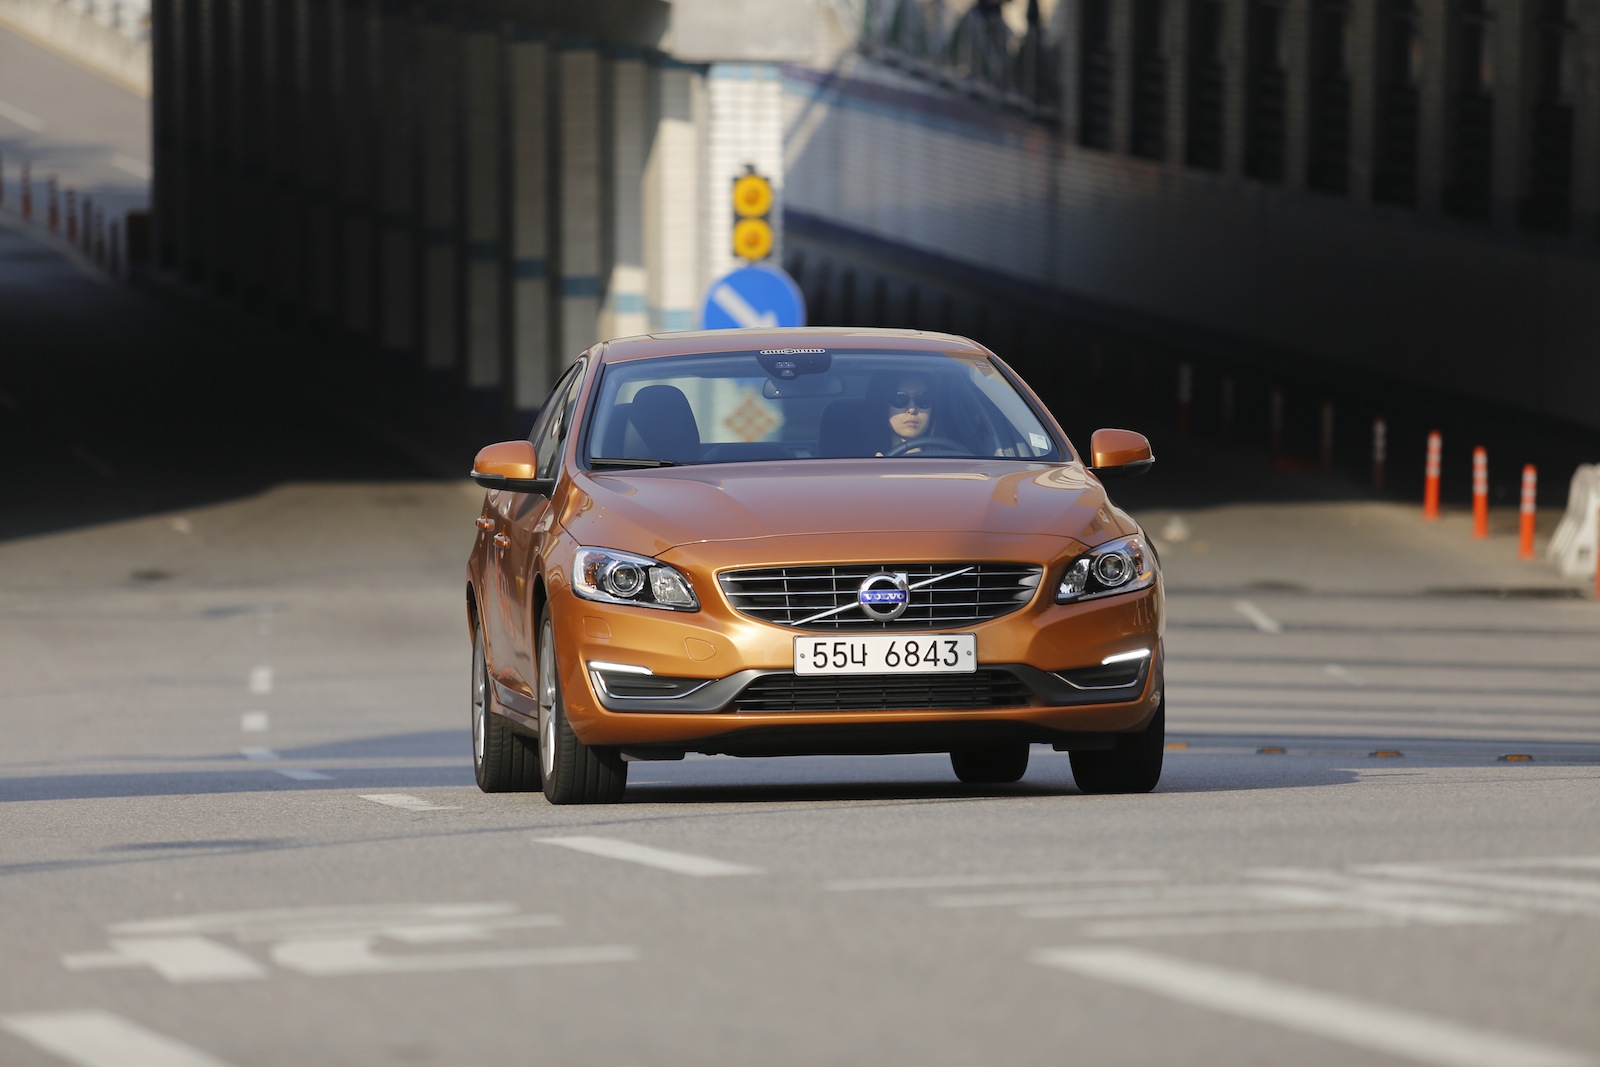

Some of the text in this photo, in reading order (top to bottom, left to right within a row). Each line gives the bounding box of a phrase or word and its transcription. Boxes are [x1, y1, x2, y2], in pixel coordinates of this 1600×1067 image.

[863, 592, 905, 600] VOLVO
[812, 640, 959, 669] 55나 6843
